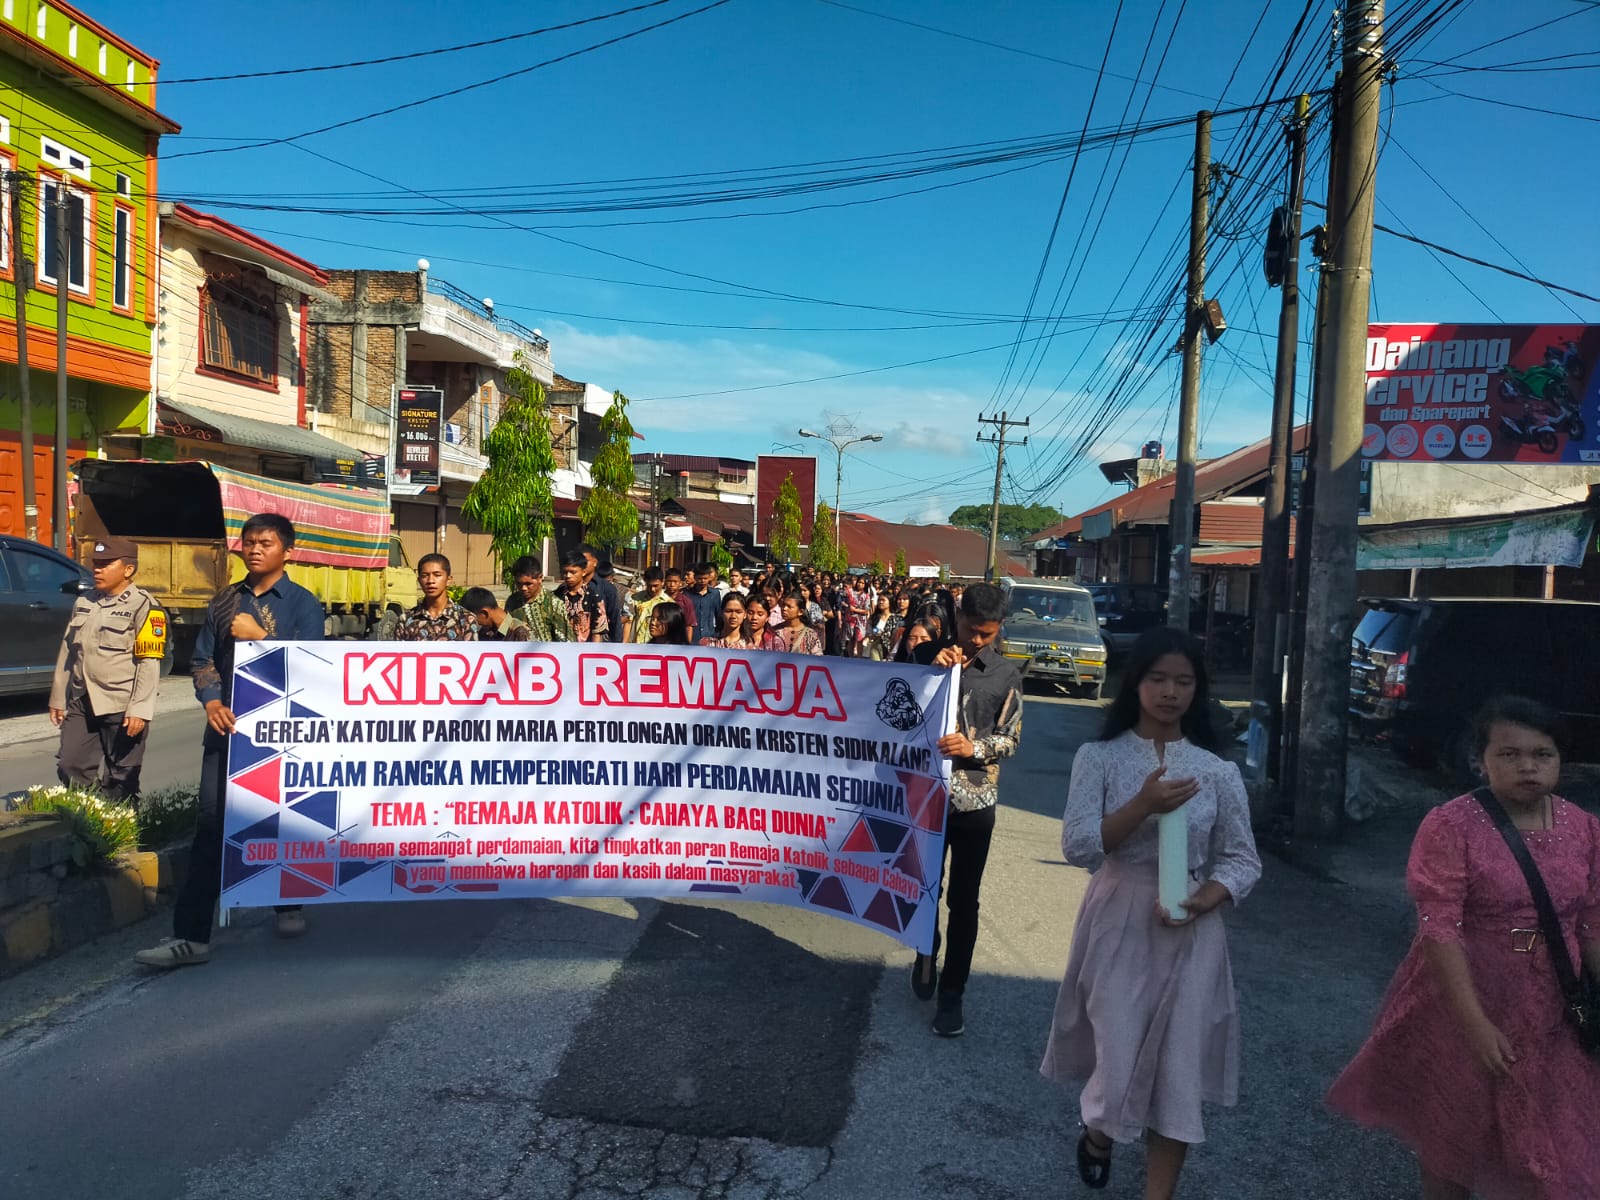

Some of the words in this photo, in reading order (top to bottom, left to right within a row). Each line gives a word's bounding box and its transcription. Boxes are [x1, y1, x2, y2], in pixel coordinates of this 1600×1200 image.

[1365, 370, 1488, 405] ervice
[401, 410, 437, 418] SIGNATURE
[1380, 407, 1408, 421] dan
[1411, 404, 1491, 422] Sparepart
[111, 610, 132, 618] POLRI
[344, 652, 563, 706] KIRAB
[578, 654, 848, 722] REMAJA
[255, 720, 331, 743] GEREJA
[336, 720, 417, 743] KATOLIK
[422, 720, 491, 743] PAROKI
[497, 720, 558, 743] MARIA
[563, 720, 688, 746] PERTOLONGAN
[692, 724, 751, 750] ORANG
[756, 728, 828, 757] KRISTEN
[833, 736, 932, 772] SIDIKALANG
[284, 761, 366, 788] DALAM
[374, 760, 464, 786] RANGKA
[470, 760, 628, 787] MEMPERINGATI
[634, 761, 682, 788] HARI
[688, 763, 821, 799] PERDAMAIAN
[827, 775, 906, 814] SEDUNIA
[370, 802, 427, 827] TEMA
[544, 801, 623, 825] KATOLIK
[639, 802, 718, 828] CAHAYA
[724, 807, 767, 833] BAGI
[246, 842, 277, 861] SUB
[283, 841, 327, 860] TEMA
[339, 840, 395, 860] Dengan
[399, 838, 472, 859] semangat
[477, 837, 566, 858] perdamaian,
[570, 837, 599, 855] kita
[603, 837, 681, 857] tingkatkan
[685, 841, 726, 858] peran
[729, 842, 780, 864] Remaja
[783, 846, 829, 870] Katolik
[833, 856, 880, 884] sebagai
[882, 868, 919, 900] Cahaya
[409, 864, 446, 885] yang
[450, 862, 526, 880] membawa
[529, 862, 590, 881] harapan
[594, 862, 619, 879] dan
[622, 863, 661, 880] kasih
[665, 863, 707, 880] dalam
